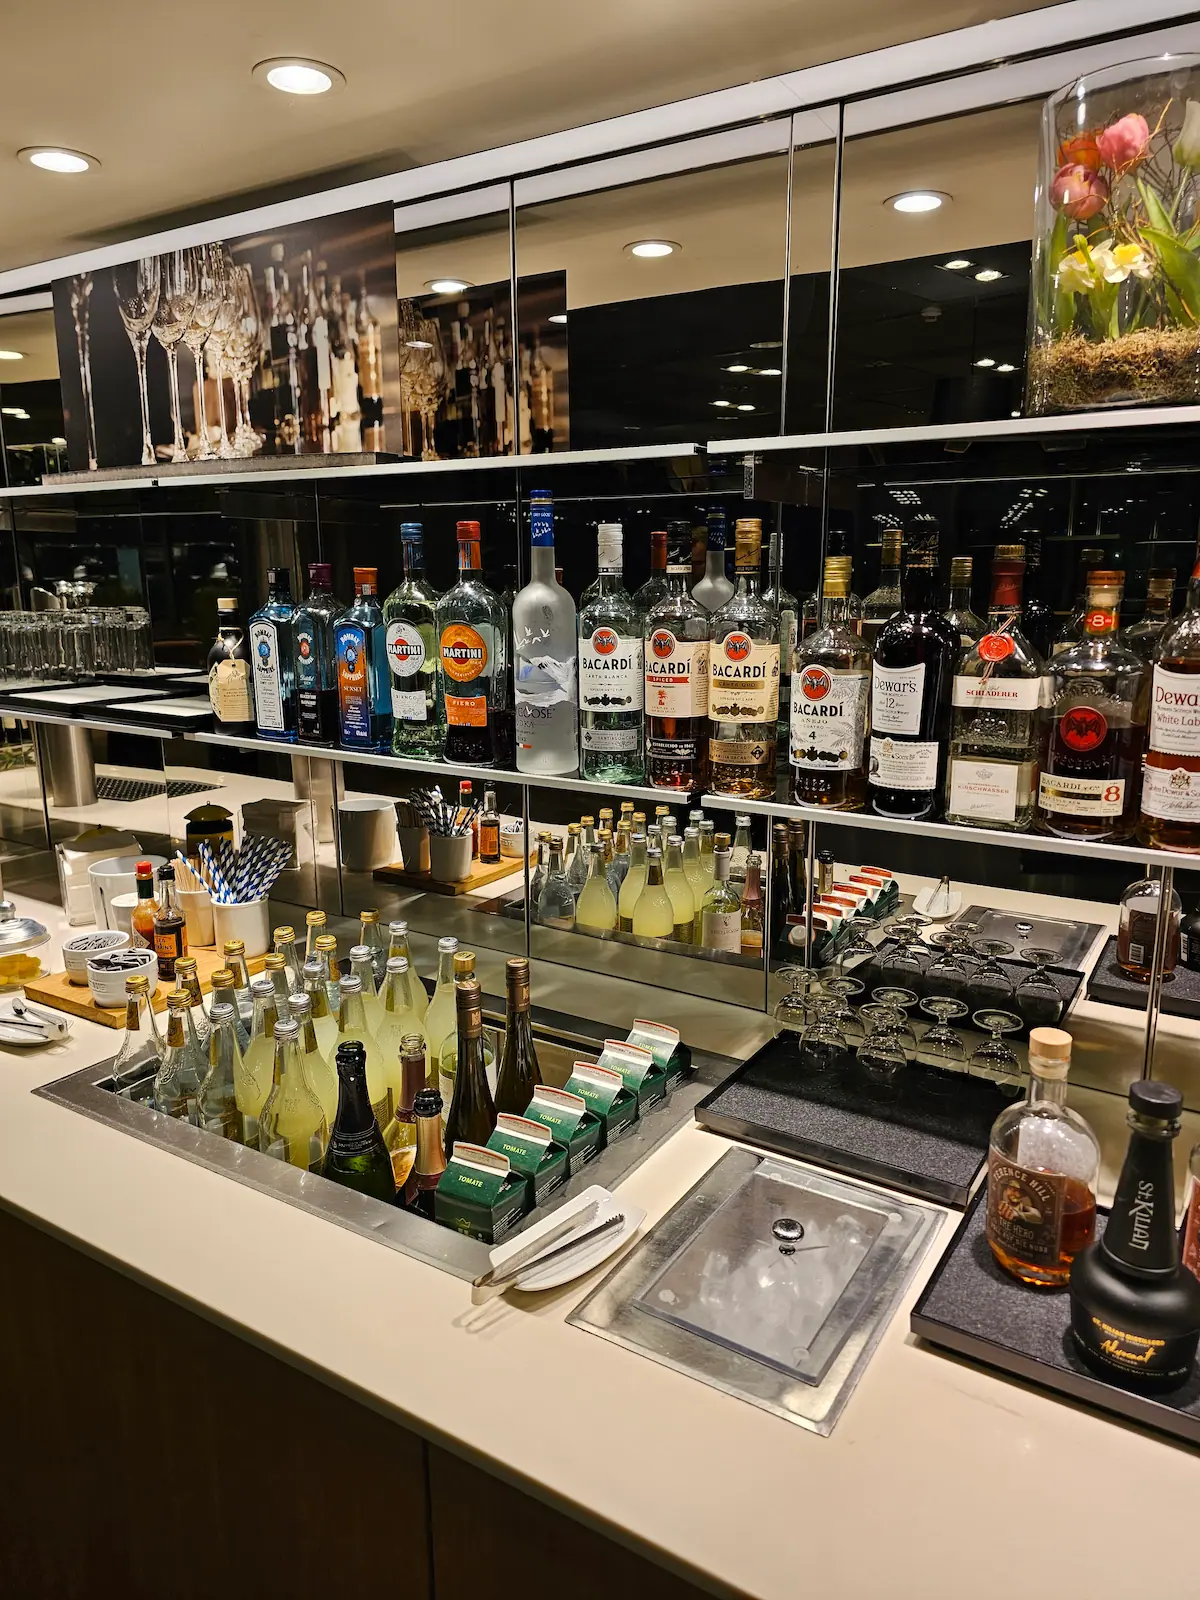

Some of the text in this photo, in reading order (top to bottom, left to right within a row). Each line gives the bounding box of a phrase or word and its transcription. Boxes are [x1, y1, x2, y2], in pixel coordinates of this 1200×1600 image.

[1092, 614, 1104, 627] 8
[254, 629, 272, 638] BOMBAY
[340, 633, 360, 645] BOMBAY
[388, 644, 421, 655] MARTINI
[443, 647, 482, 658] MARTINI
[257, 663, 275, 673] SAPPHIRE
[582, 655, 632, 670] BACARDÍ
[342, 668, 364, 681] SAPPHIRE
[712, 661, 766, 678] BACARDÍ
[875, 676, 917, 693] Dewar's
[966, 689, 1018, 698] SCHLADERER
[1156, 686, 1200, 707] Dewa
[885, 697, 895, 708] 12
[793, 702, 843, 717] BACARDÍ
[1156, 712, 1180, 725] White
[808, 731, 817, 740] 4
[957, 785, 1009, 794] KIRSCHWASSER
[1104, 785, 1120, 802] 8
[638, 1042, 658, 1052] TOMATE
[610, 1064, 631, 1075] TOMATE
[577, 1088, 600, 1100] TOMATE
[539, 1113, 562, 1125] TOMATE
[502, 1143, 527, 1155] TOMATE
[458, 1175, 484, 1188] TOMATE
[993, 1166, 1051, 1202] TERENCE HILL
[1013, 1224, 1034, 1240] HERO
